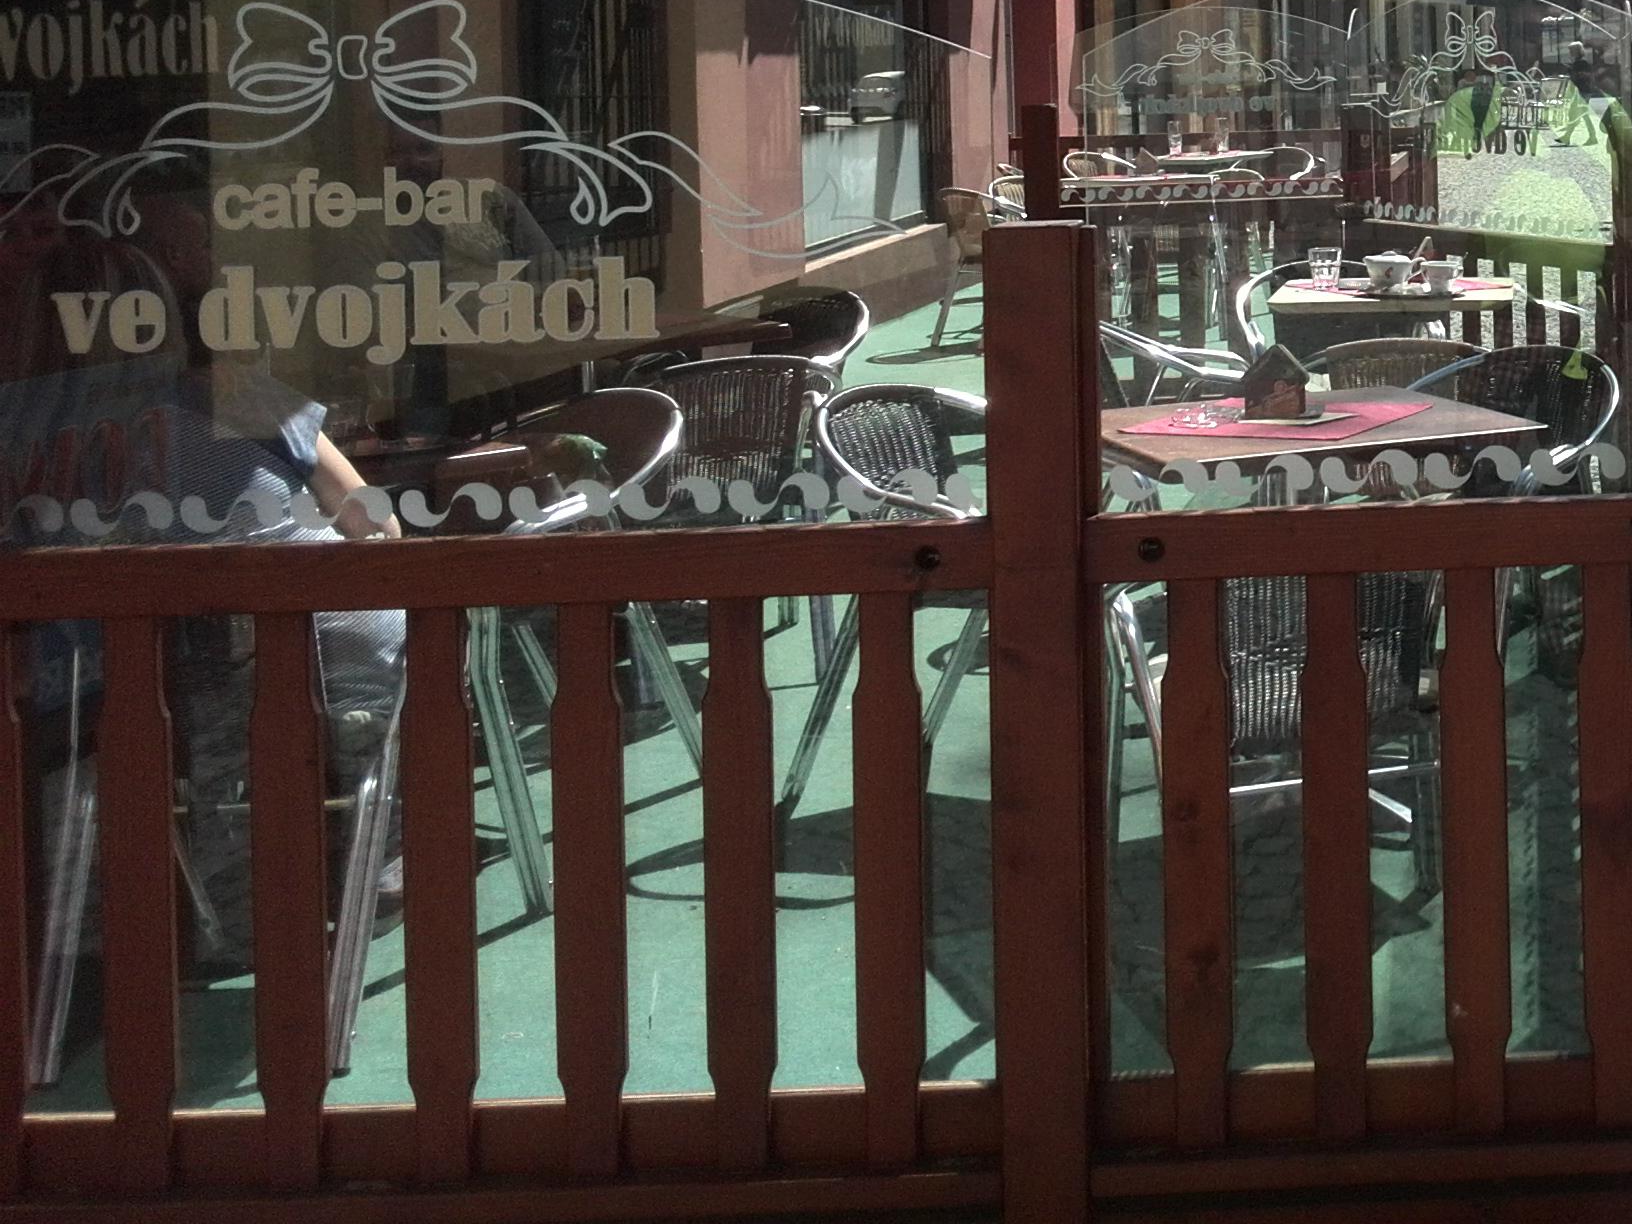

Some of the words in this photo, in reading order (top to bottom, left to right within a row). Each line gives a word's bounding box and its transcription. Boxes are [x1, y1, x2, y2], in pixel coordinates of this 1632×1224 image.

[212, 166, 497, 230] cafe-bar
[51, 289, 167, 354] ve
[199, 257, 660, 365] dvojkách
